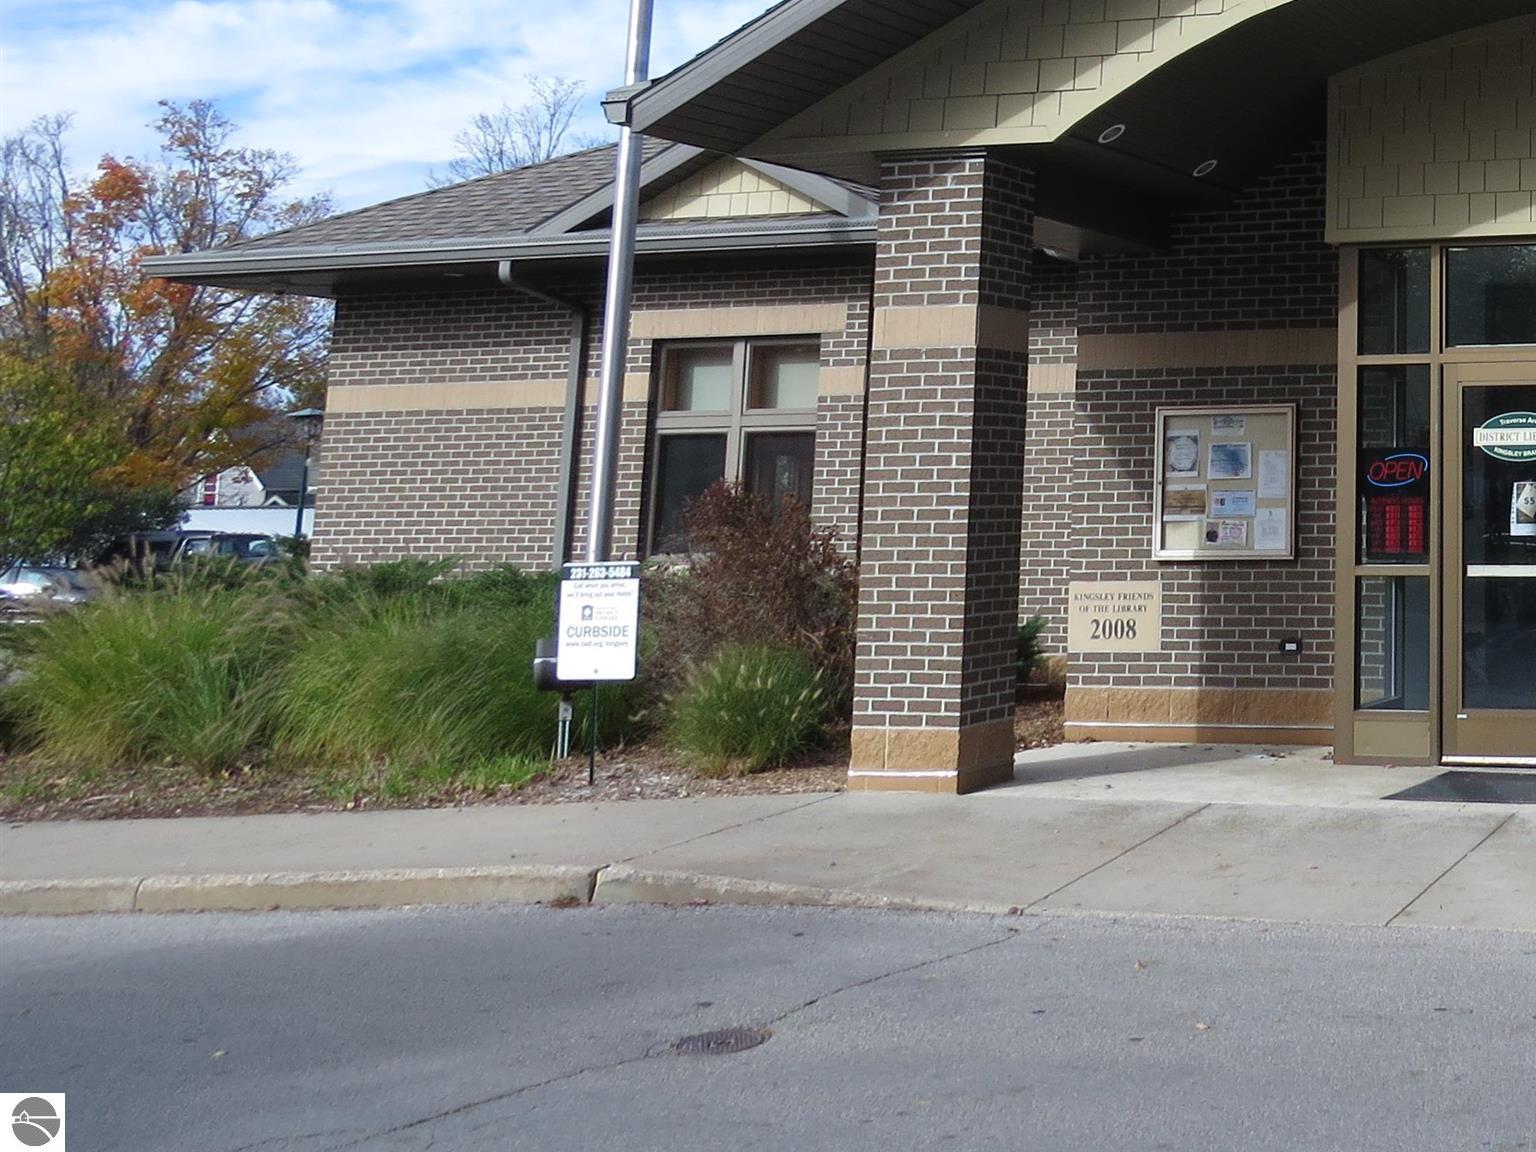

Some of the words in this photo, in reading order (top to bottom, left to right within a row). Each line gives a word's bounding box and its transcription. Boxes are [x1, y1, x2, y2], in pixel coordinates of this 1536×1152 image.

[1499, 417, 1526, 426] Traverse
[1479, 431, 1521, 442] DISTRICT
[1493, 446, 1522, 457] KINGSLEY
[1369, 460, 1424, 481] OPEN
[570, 566, 632, 579] 231-263-5484
[1074, 592, 1115, 601] KINGSLEY
[1118, 592, 1155, 600] FRIENDS
[1079, 604, 1089, 613] OF
[1093, 604, 1109, 613] THE
[1112, 604, 1148, 613] LIBRARY
[566, 625, 630, 638] CURBSIDE
[1090, 618, 1137, 640] 2008
